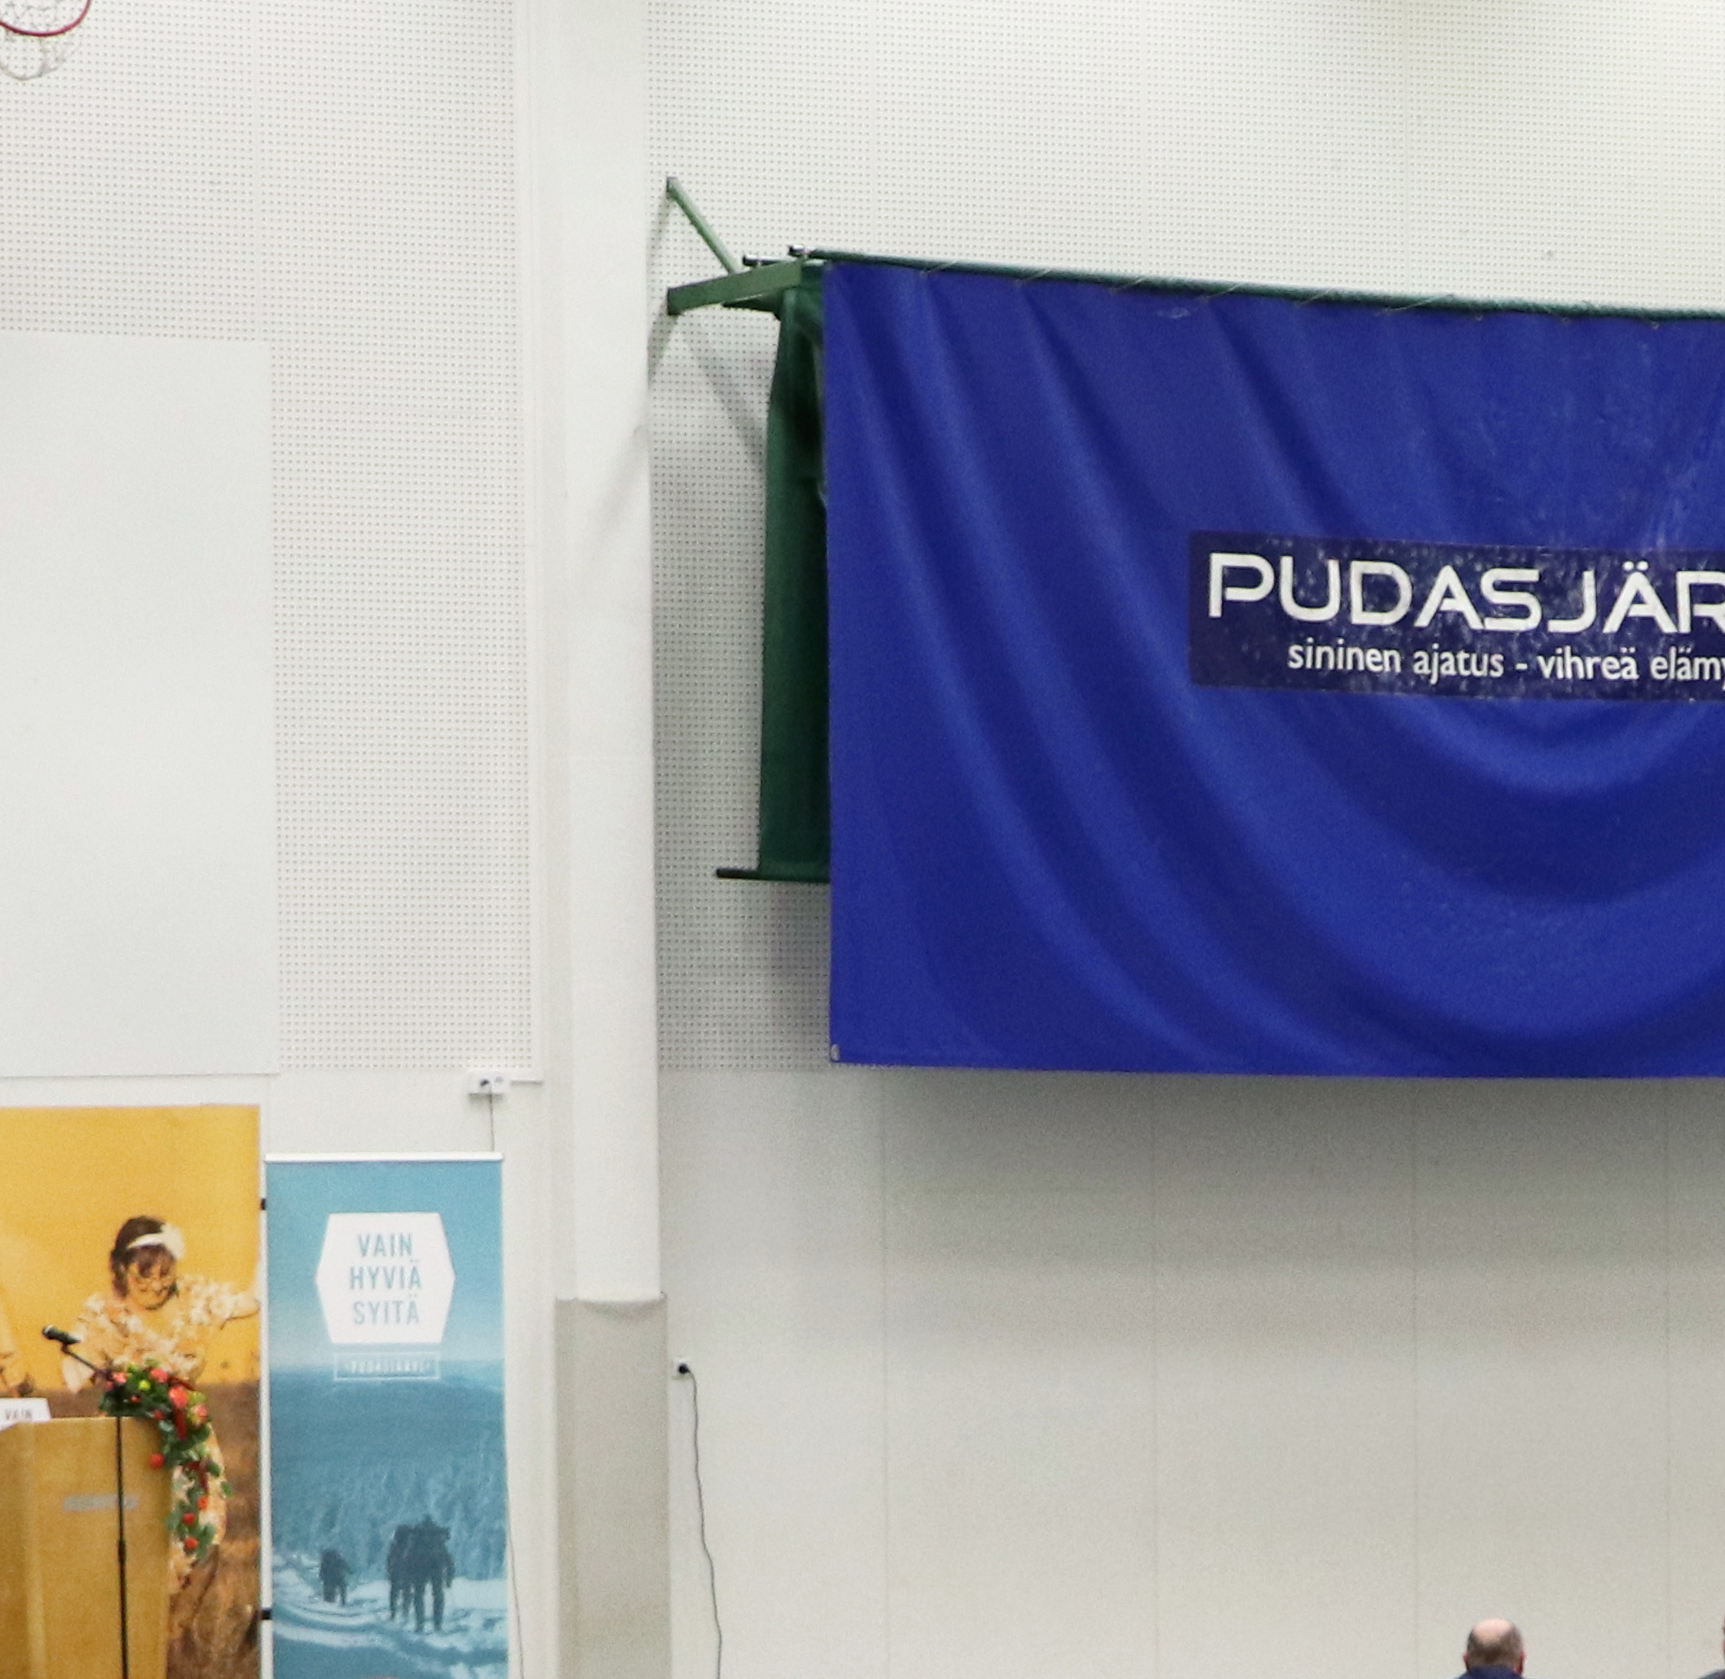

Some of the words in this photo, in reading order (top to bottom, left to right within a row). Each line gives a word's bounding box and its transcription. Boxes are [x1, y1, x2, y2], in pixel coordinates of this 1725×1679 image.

[1287, 637, 1402, 673] sininen
[1413, 643, 1505, 685] ajatus
[1537, 645, 1639, 680] vihreä
[357, 1233, 412, 1258] VAIN
[349, 1259, 422, 1291] HYVIÄ
[352, 1294, 419, 1326] SYITÄ
